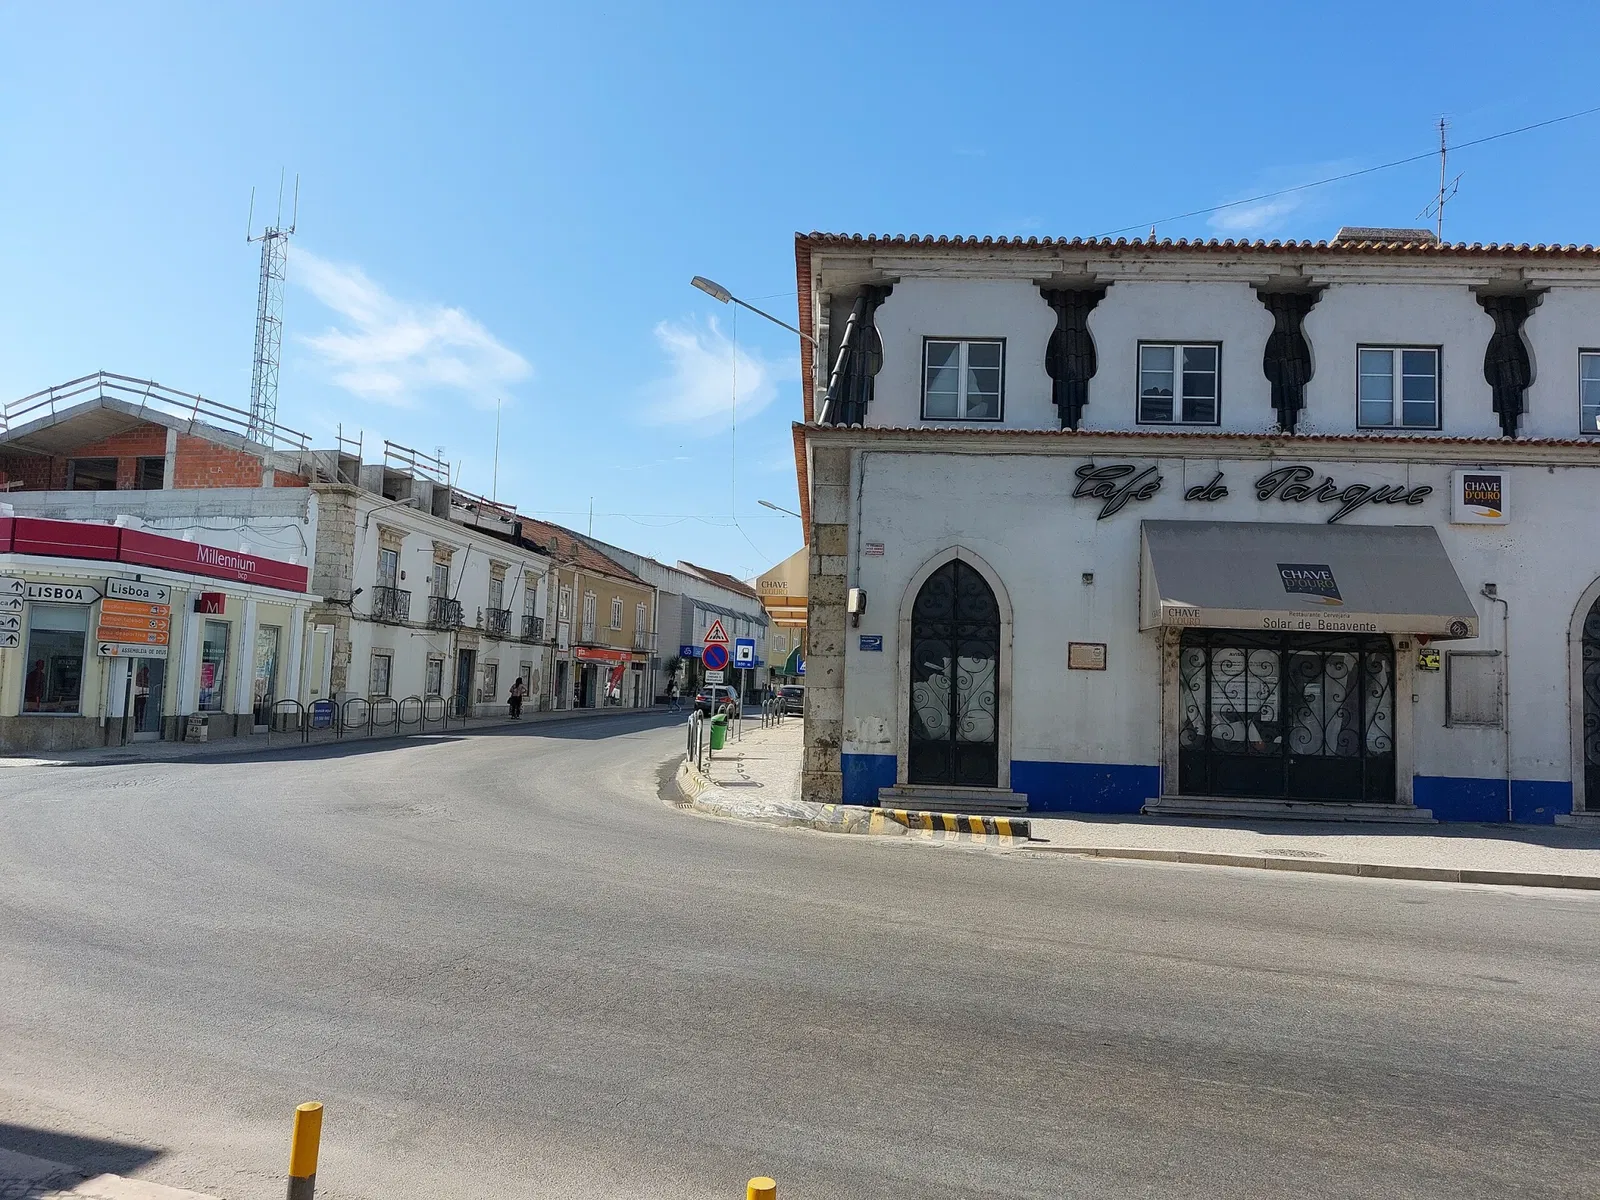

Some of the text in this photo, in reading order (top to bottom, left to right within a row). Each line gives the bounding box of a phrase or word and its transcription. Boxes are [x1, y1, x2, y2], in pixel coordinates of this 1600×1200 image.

[1464, 481, 1500, 492] CHAVE
[1073, 463, 1164, 521] Café
[1254, 465, 1434, 525] Parque
[1465, 491, 1500, 500] D'OURO
[196, 543, 256, 572] Millennium
[237, 571, 248, 581] bcp
[1281, 569, 1331, 580] CHAVE
[761, 580, 788, 589] CHAVE
[1285, 579, 1335, 589] D'OURO
[28, 586, 83, 600] LISBOA
[111, 582, 149, 598] Lisboa
[206, 599, 219, 614] M
[1168, 608, 1201, 618] CHAVE
[1263, 617, 1377, 633] Solar de Benavente
